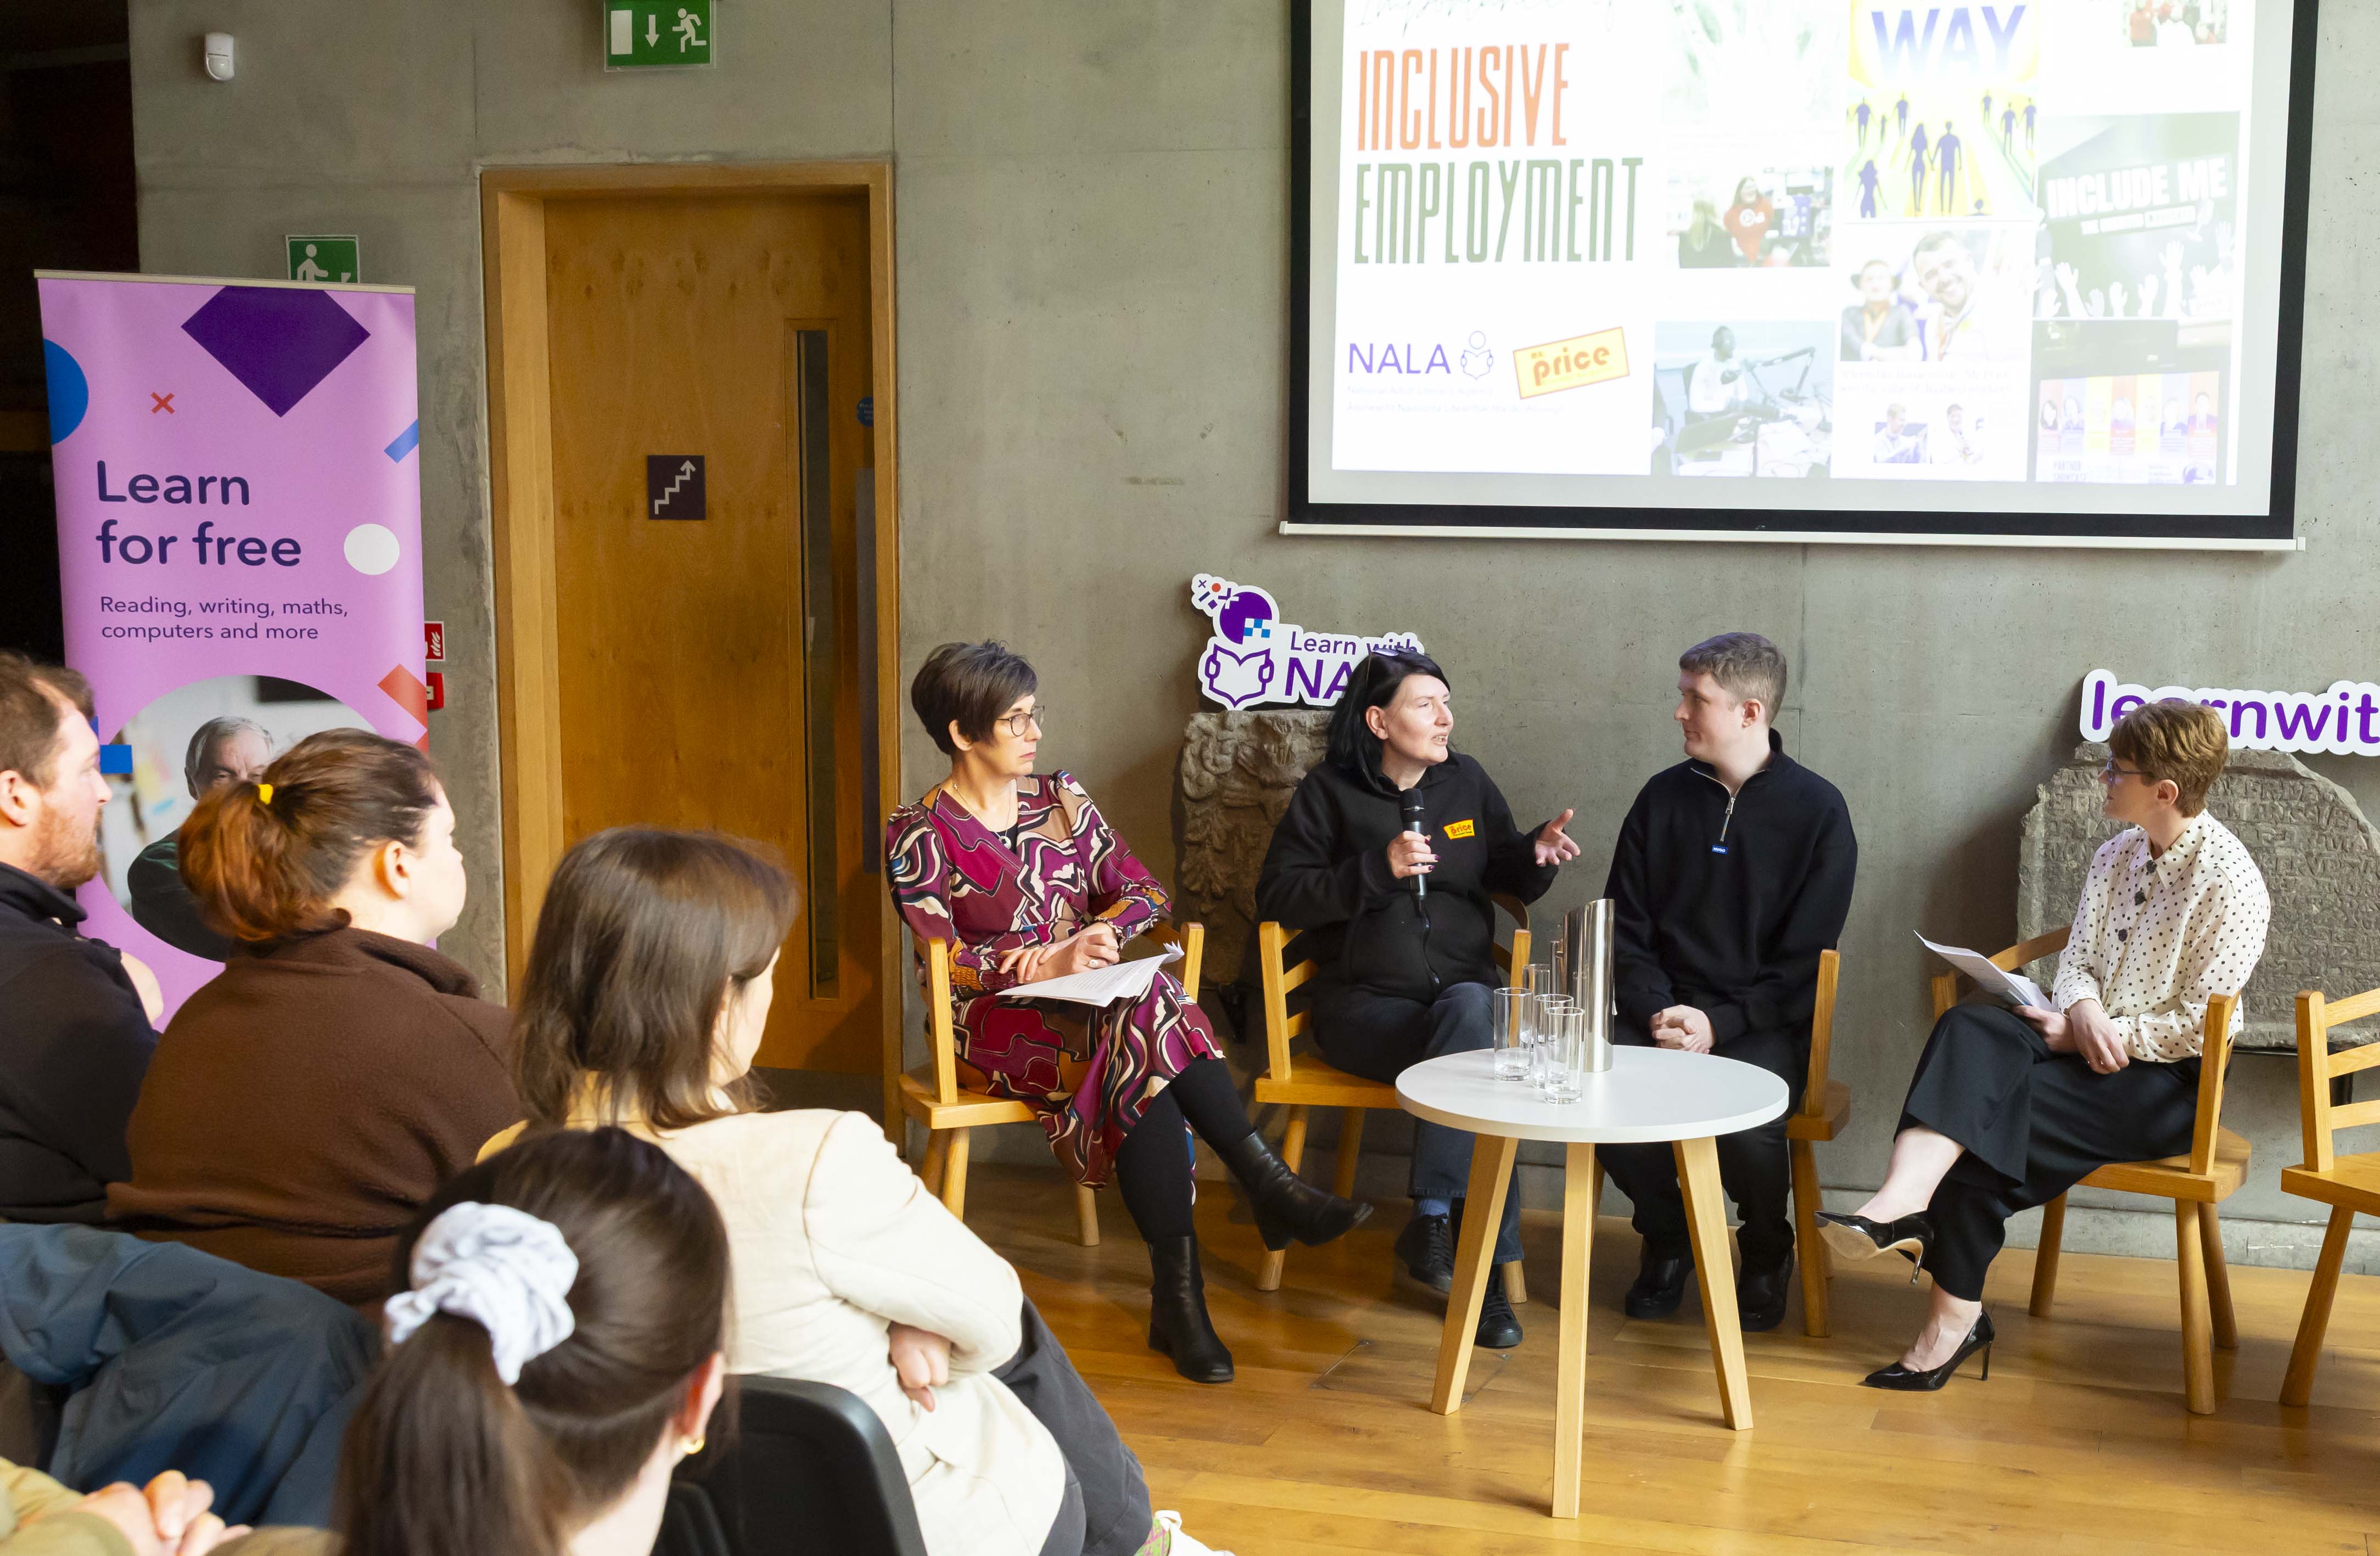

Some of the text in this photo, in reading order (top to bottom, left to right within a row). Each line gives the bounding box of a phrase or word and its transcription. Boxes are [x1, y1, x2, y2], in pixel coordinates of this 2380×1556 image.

[1871, 4, 2026, 77] WAY
[1358, 43, 1569, 151] INCLUSIVE
[1354, 157, 1643, 264] EMPLOYMENT
[2046, 165, 2170, 219] INCLUDE
[2177, 157, 2227, 203] ME
[1348, 343, 1451, 374] NALA
[1533, 346, 1610, 387] price
[97, 460, 250, 505] Learn
[96, 519, 302, 567] for free
[100, 596, 348, 618] Reading, writing, maths,
[102, 622, 318, 642] computers and more
[1290, 631, 1357, 655] Learn
[1285, 658, 1353, 699] NA
[2092, 680, 2380, 744] lernwit
